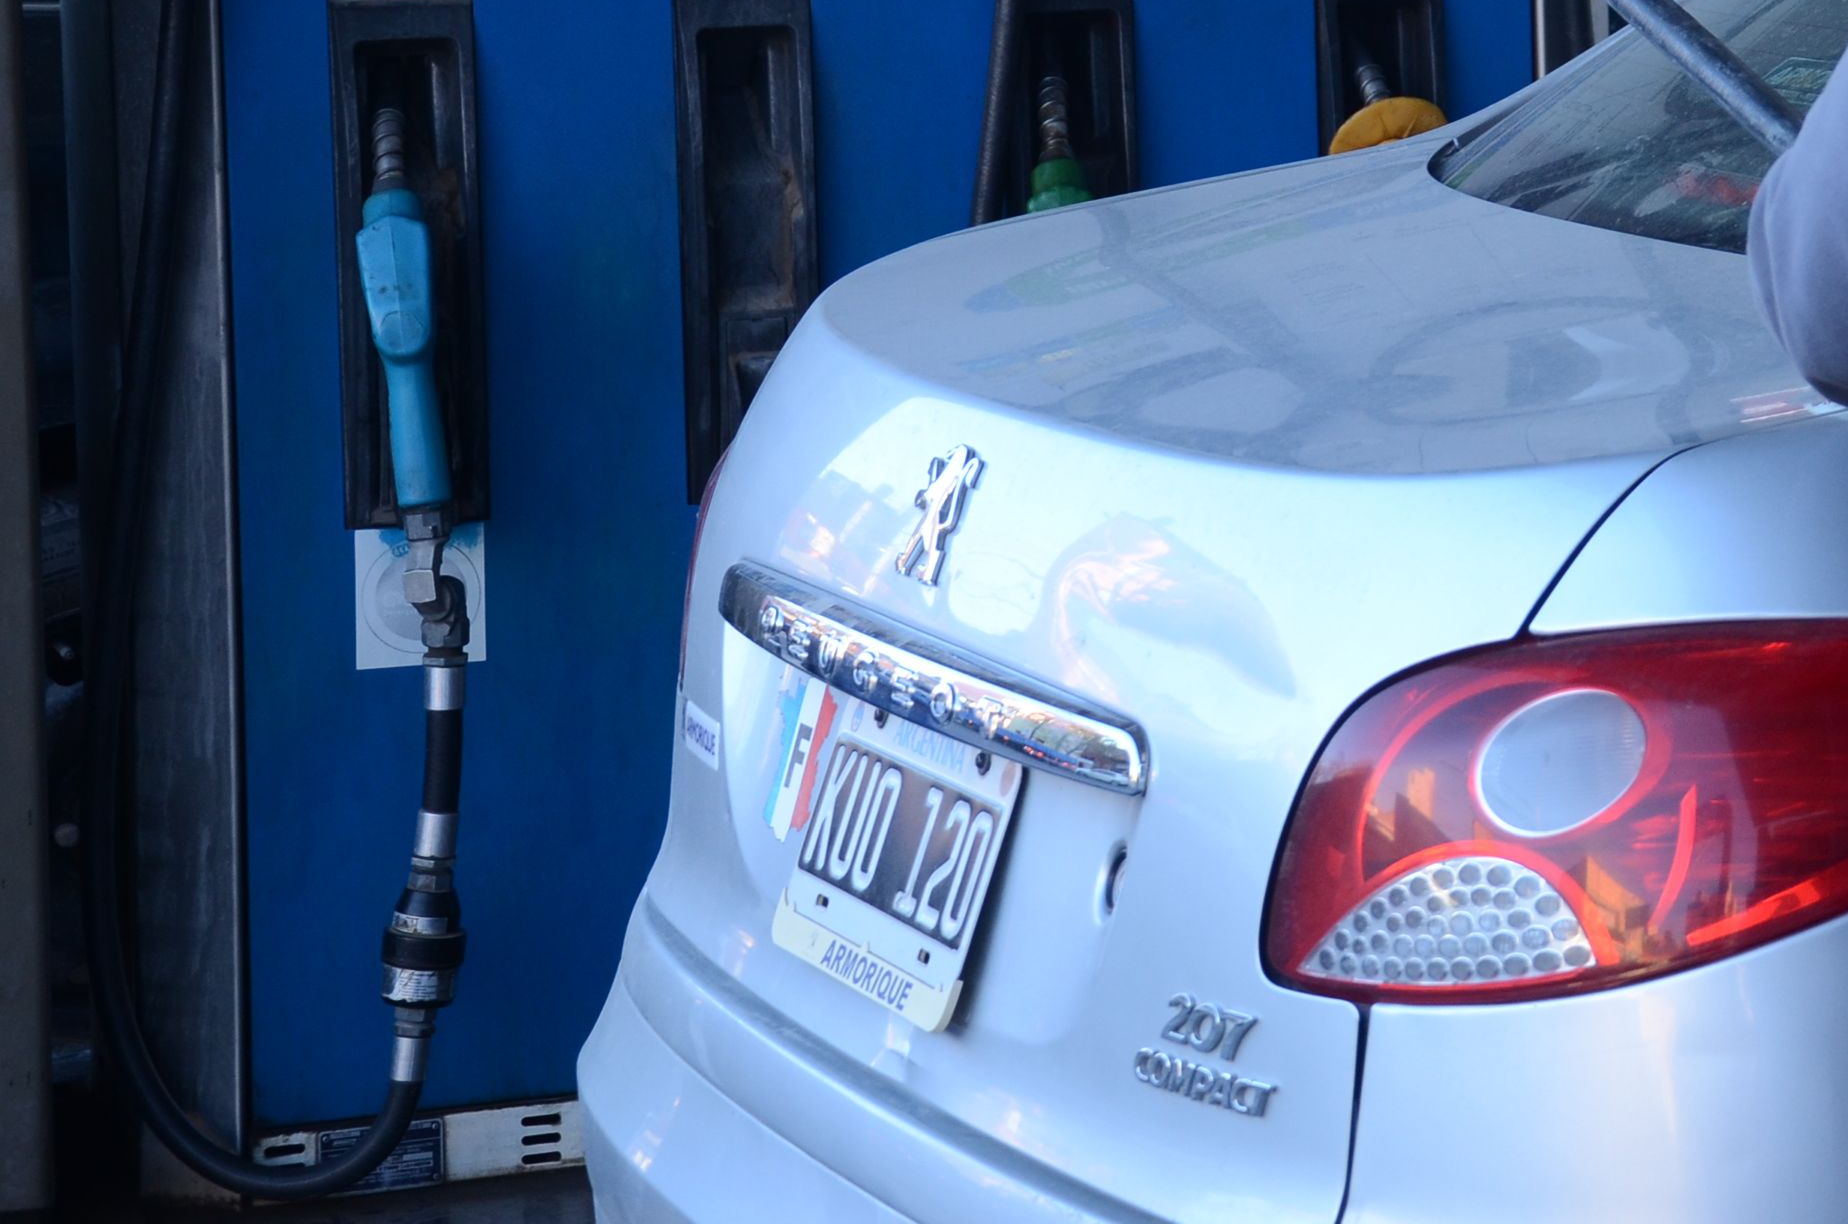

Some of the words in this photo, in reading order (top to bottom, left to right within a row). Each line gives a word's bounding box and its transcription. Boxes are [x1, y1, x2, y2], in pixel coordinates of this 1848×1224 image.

[784, 722, 812, 788] F
[802, 744, 903, 892] KUO
[892, 786, 994, 942] 120
[821, 938, 913, 1011] ARMORIQUE
[1161, 991, 1260, 1062] 207
[1134, 1046, 1280, 1118] COMPACT
